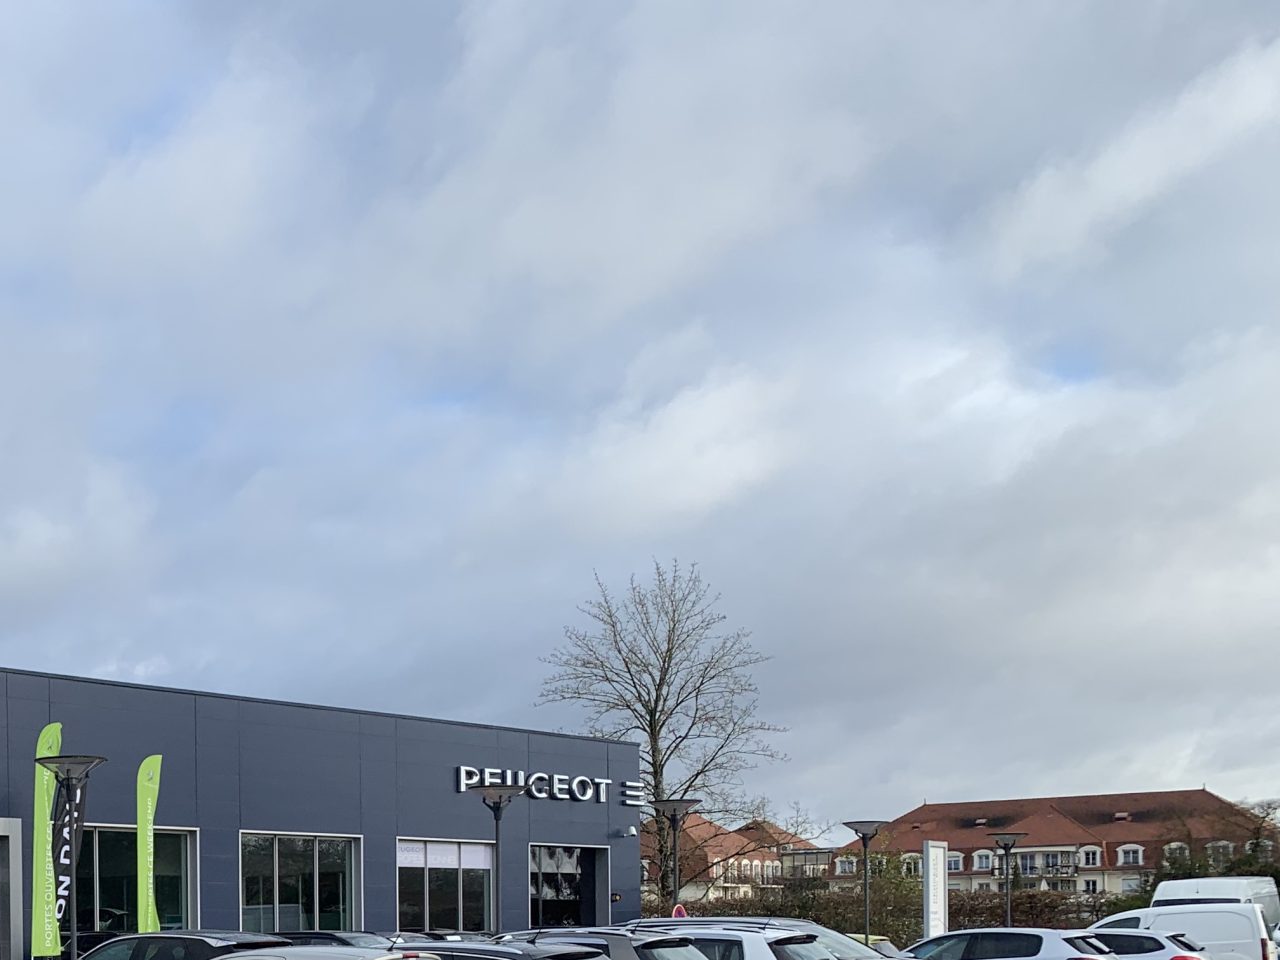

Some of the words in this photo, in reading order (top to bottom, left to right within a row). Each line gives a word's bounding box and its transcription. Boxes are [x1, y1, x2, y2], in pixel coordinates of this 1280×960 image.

[458, 765, 613, 802] PEUGEOT
[45, 842, 54, 901] OUVERTES
[45, 904, 53, 947] PORTES
